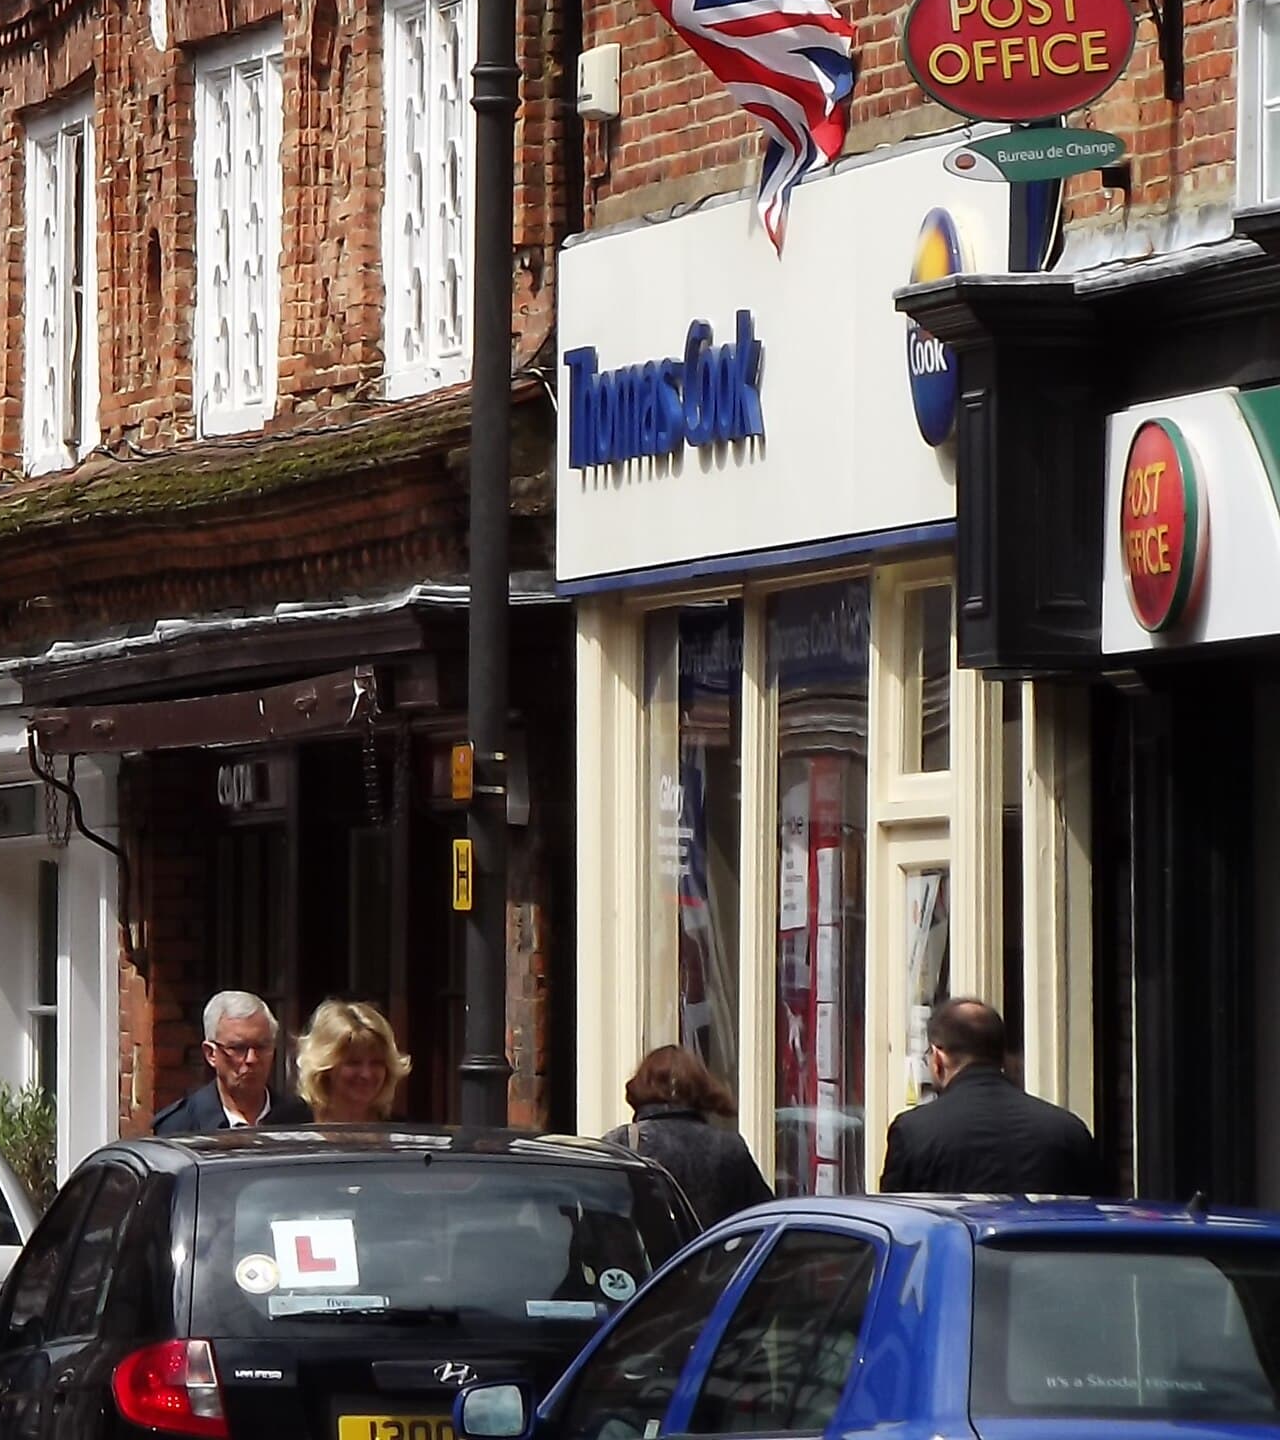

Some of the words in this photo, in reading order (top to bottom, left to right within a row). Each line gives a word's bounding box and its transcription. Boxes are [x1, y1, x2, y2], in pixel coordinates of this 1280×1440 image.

[928, 30, 1110, 85] OFFICE
[997, 149, 1044, 164] Bureau
[1046, 146, 1064, 160] de
[1066, 141, 1117, 157] Change
[909, 331, 949, 376] Cook
[683, 309, 764, 447] Cook
[294, 1235, 337, 1272] L
